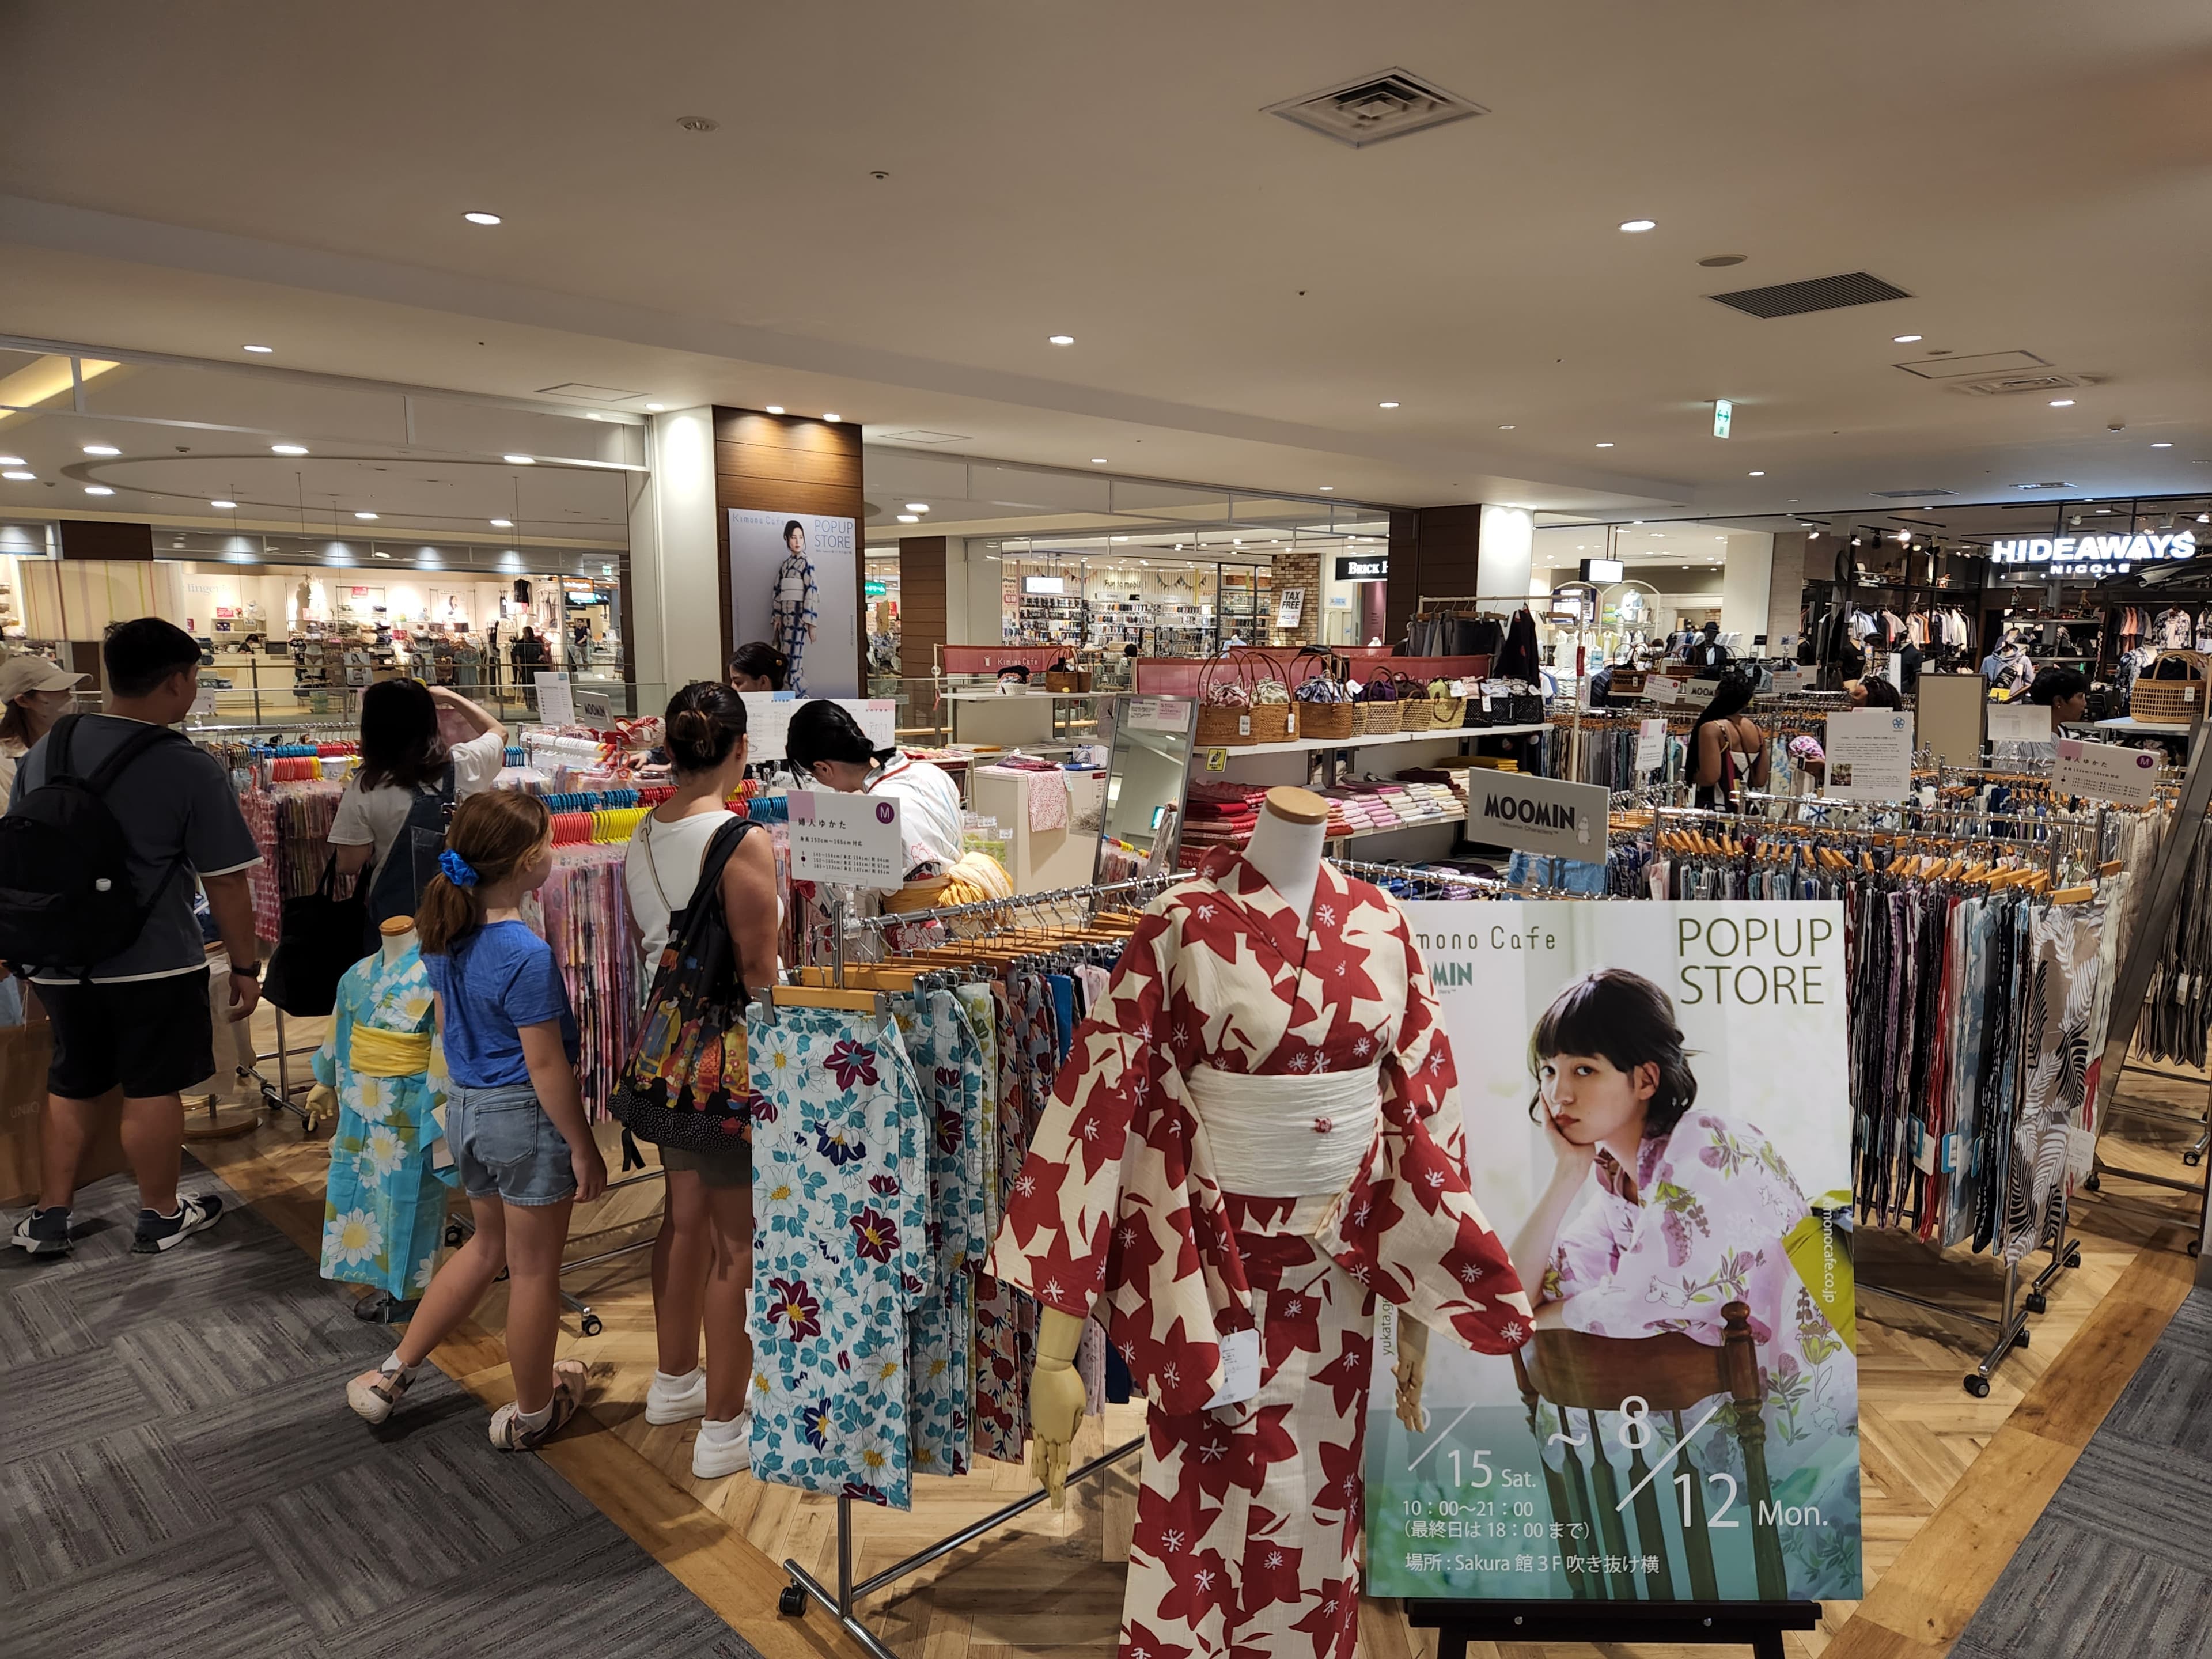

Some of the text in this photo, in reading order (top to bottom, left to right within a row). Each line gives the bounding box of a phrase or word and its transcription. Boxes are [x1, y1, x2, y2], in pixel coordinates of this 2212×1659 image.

[733, 513, 785, 526] Kimono Cafe
[815, 519, 853, 534] POPUP
[815, 535, 851, 549] STORE
[1991, 533, 2196, 563] HIDEAWAYS
[1348, 562, 1380, 574] BRICK
[2050, 563, 2131, 575] NICOLE
[1104, 579, 1116, 587] Fun
[1285, 590, 1301, 601] TAX
[1282, 600, 1300, 609] FREE
[1022, 657, 1037, 665] Cafe
[1691, 687, 1714, 696] MOOM
[2139, 757, 2149, 766] M
[880, 806, 890, 819] M
[1484, 793, 1575, 831] MOOMIN
[798, 817, 847, 830] 婦人ゆかた
[1416, 926, 1555, 950] mono Cafe
[1679, 918, 1833, 957] POPUP
[1432, 961, 1473, 987] MIN
[1680, 965, 1824, 1005] STORE
[1822, 1208, 1837, 1303] monocafe.co.jp
[1501, 1469, 1536, 1488] Sat.
[1758, 1499, 1828, 1527] Mon.
